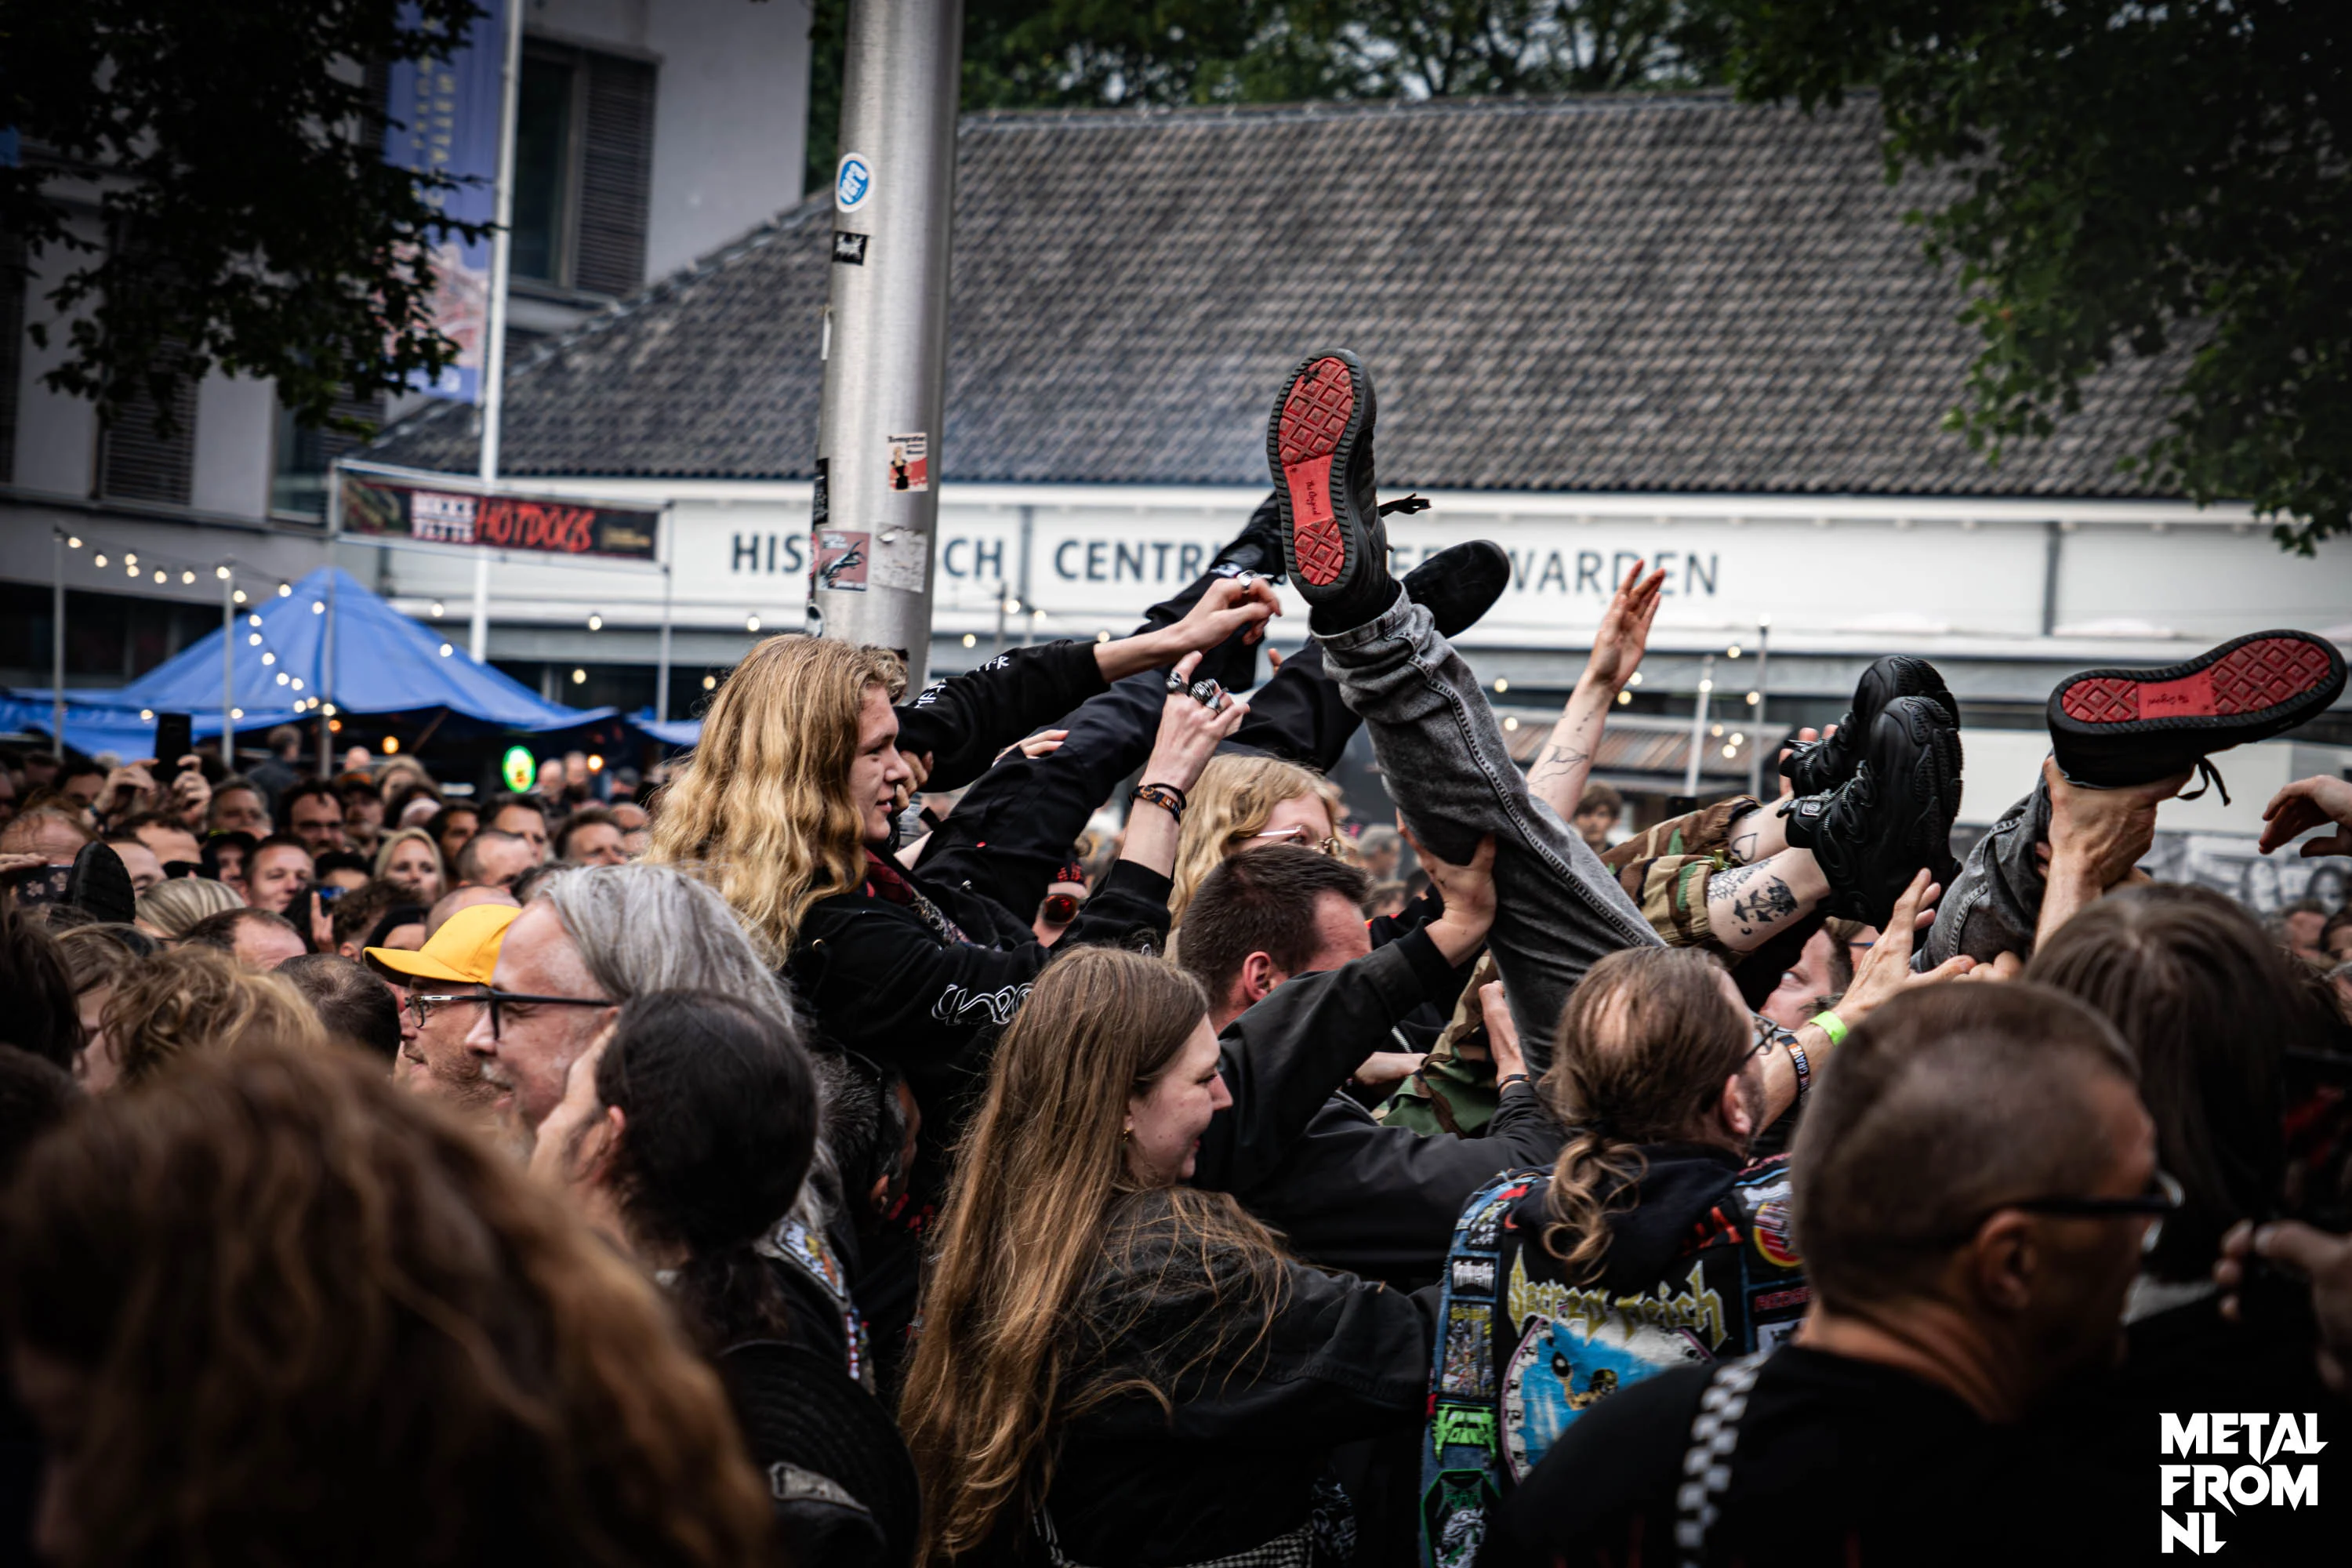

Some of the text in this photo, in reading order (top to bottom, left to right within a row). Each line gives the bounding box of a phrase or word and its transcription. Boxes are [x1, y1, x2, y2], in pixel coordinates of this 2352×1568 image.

[475, 497, 596, 554] HOTDOGS
[732, 533, 1003, 579] HISCH
[1054, 539, 1221, 583] CENTR
[1789, 1044, 1809, 1075] GRAVE
